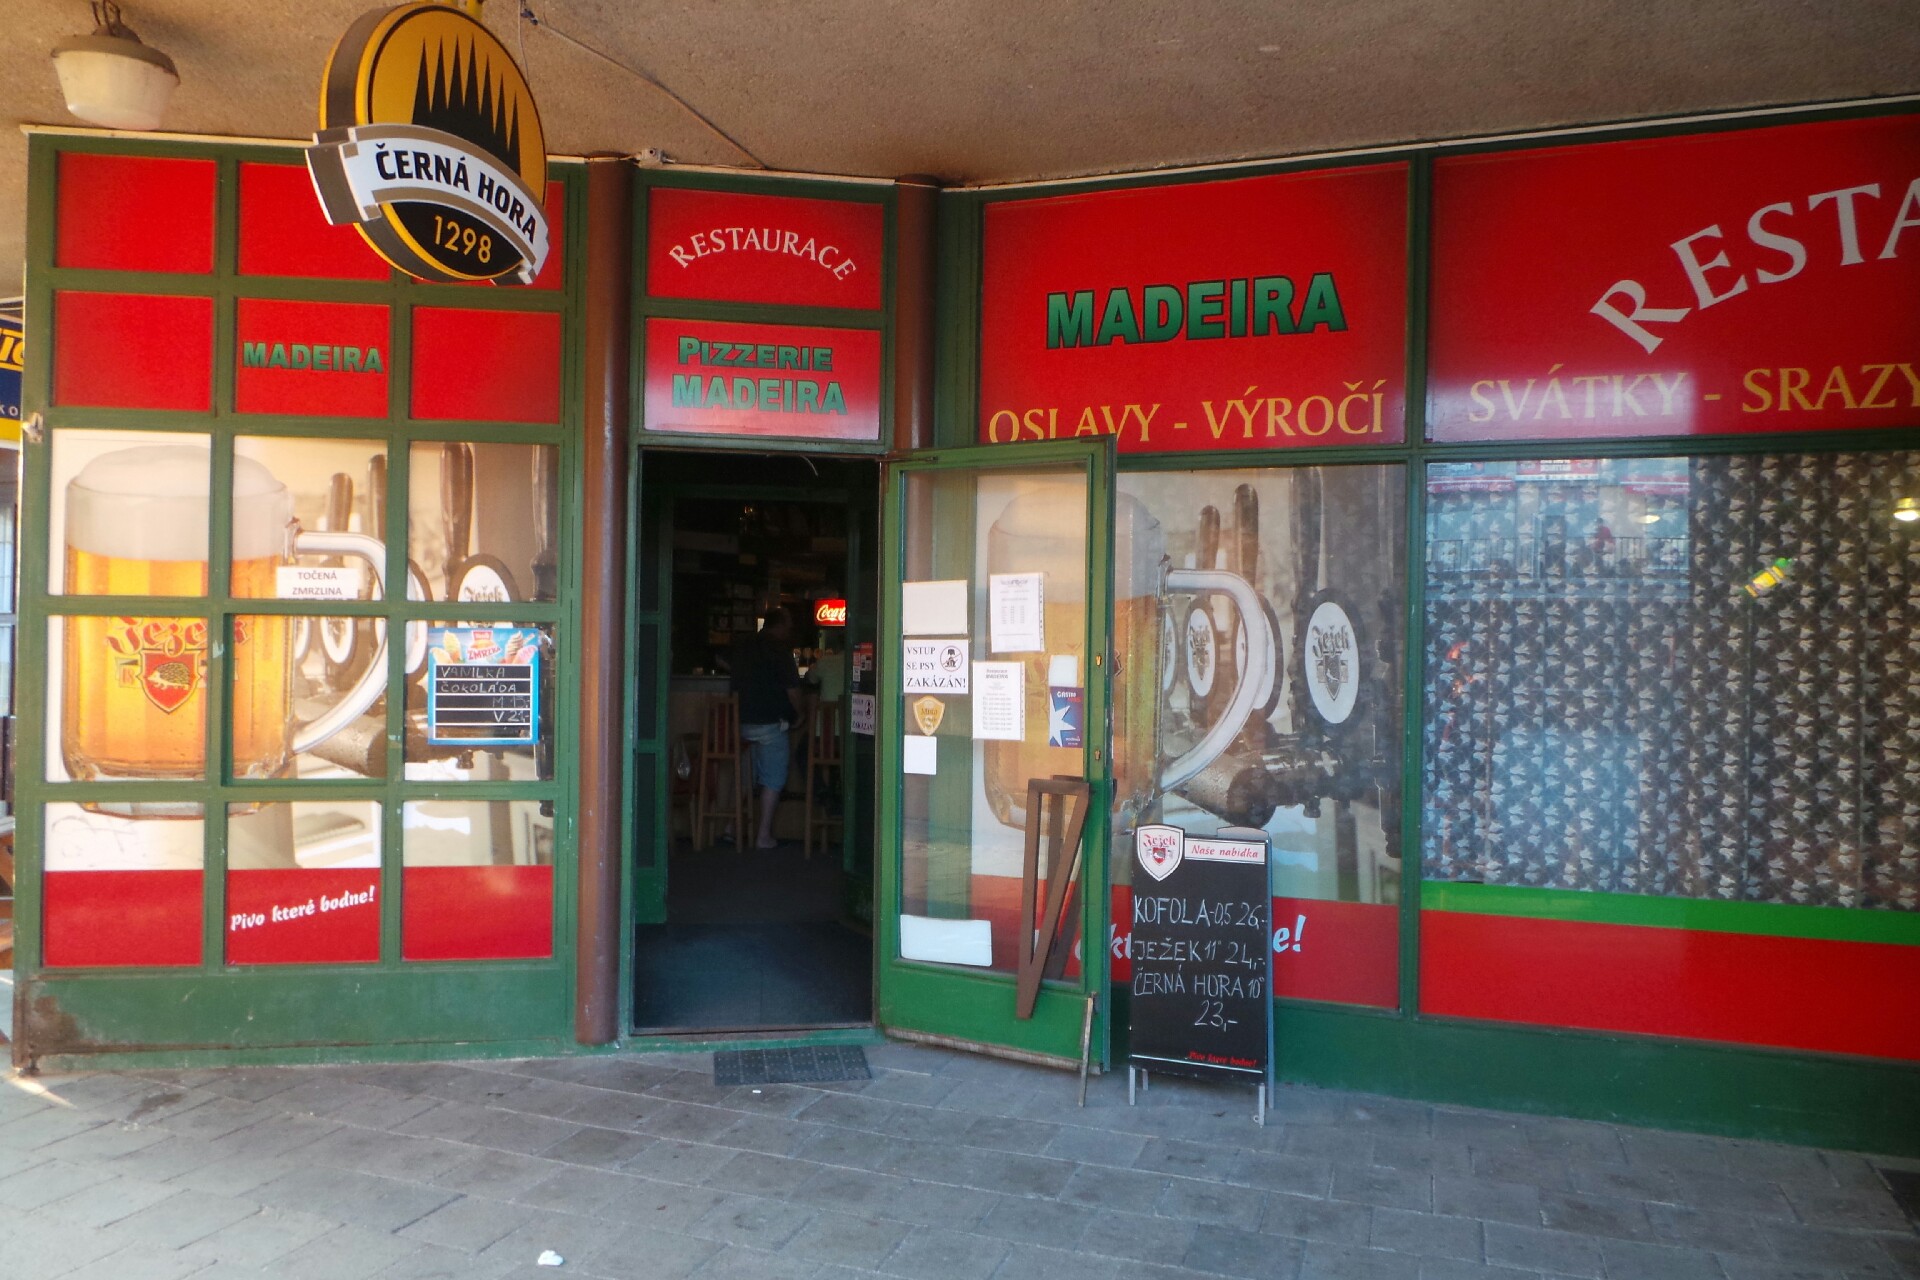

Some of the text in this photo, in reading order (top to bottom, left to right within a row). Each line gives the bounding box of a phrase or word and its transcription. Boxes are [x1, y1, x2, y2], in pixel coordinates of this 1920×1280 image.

[375, 142, 537, 245] ČERNÁ HORA
[433, 214, 492, 264] 1298
[668, 227, 857, 281] RESTAURACE
[1046, 271, 1349, 350] MADEIRA
[242, 341, 384, 374] MADEIRA
[677, 335, 833, 372] PIZZERIE
[671, 373, 848, 416] MADEIRA
[1468, 363, 1689, 423] SVÁTKY
[1741, 363, 1920, 415] SRAZY
[988, 404, 1160, 443] OSLAVY
[1203, 379, 1388, 439] VÝROČÍ
[292, 586, 343, 596] ZMRZLINA
[297, 569, 338, 581] TOČENÁ
[906, 646, 936, 655] VSTUP
[906, 662, 936, 670] SE PSY
[441, 666, 505, 679] VANILKA
[441, 680, 517, 694] ČOKOLÁDA
[906, 674, 966, 688] ZAKÁZÁN!
[493, 710, 505, 723] V
[1143, 834, 1176, 848] Ježek
[1191, 844, 1259, 859] Naše nabídka
[230, 884, 376, 932] Pivo které bodne!
[1134, 937, 1203, 962] JEŽEK
[1134, 964, 1186, 997] ČERNÁ
[1193, 973, 1244, 999] HORA
[1194, 999, 1239, 1033] 23,-
